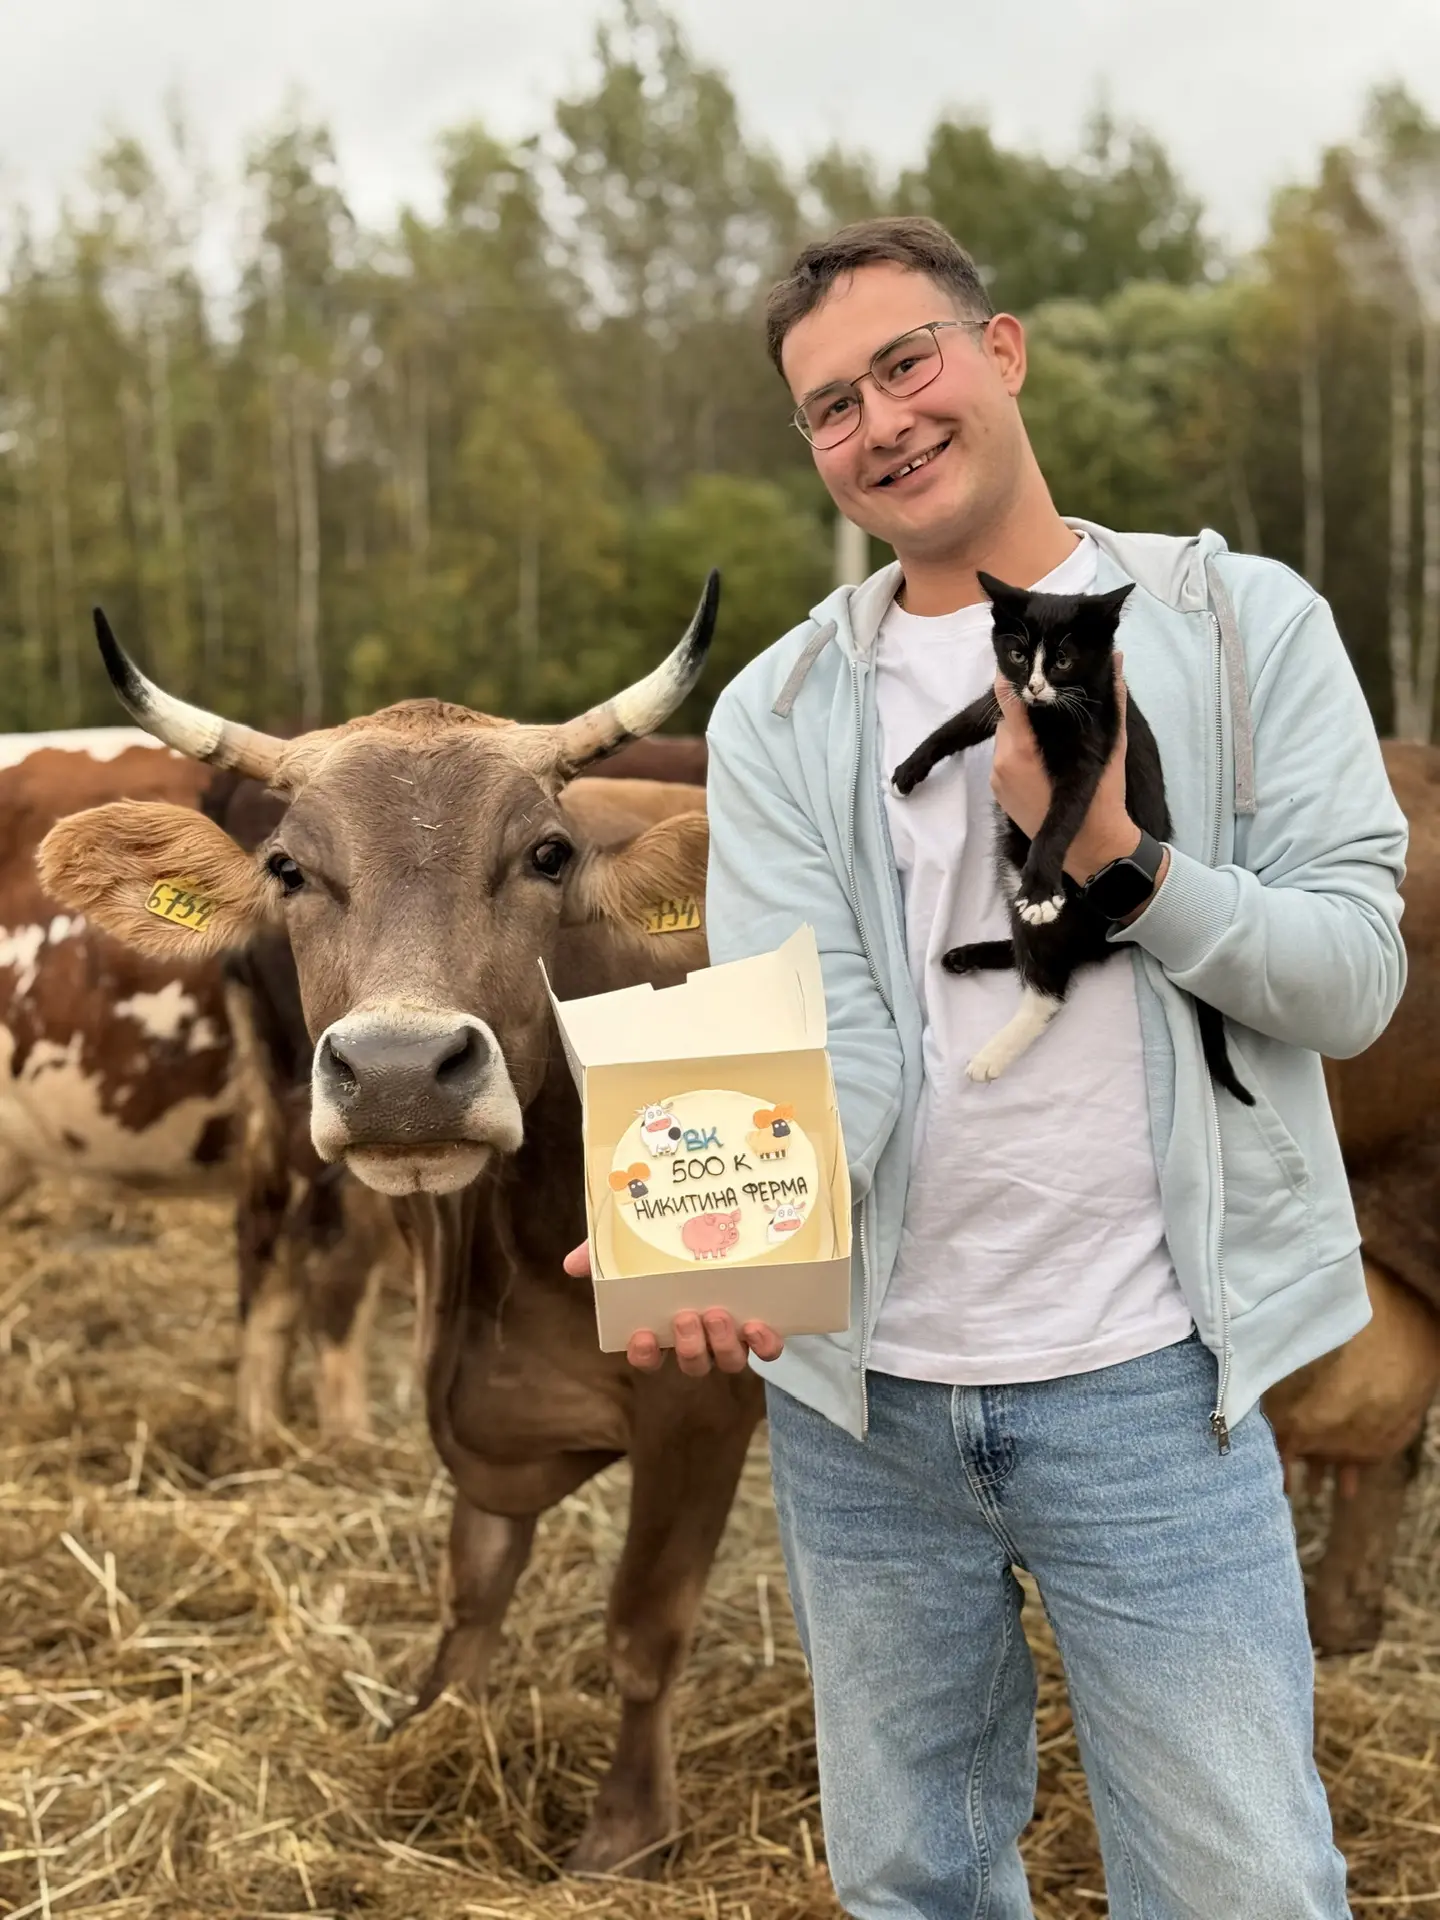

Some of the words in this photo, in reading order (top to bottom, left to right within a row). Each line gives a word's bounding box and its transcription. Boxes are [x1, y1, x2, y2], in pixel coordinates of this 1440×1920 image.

[683, 1126, 724, 1152] ВК
[672, 1156, 725, 1184] 500
[734, 1154, 752, 1171] К
[634, 1187, 738, 1220] НИКИТИНА
[742, 1176, 808, 1203] ФЕРМА
